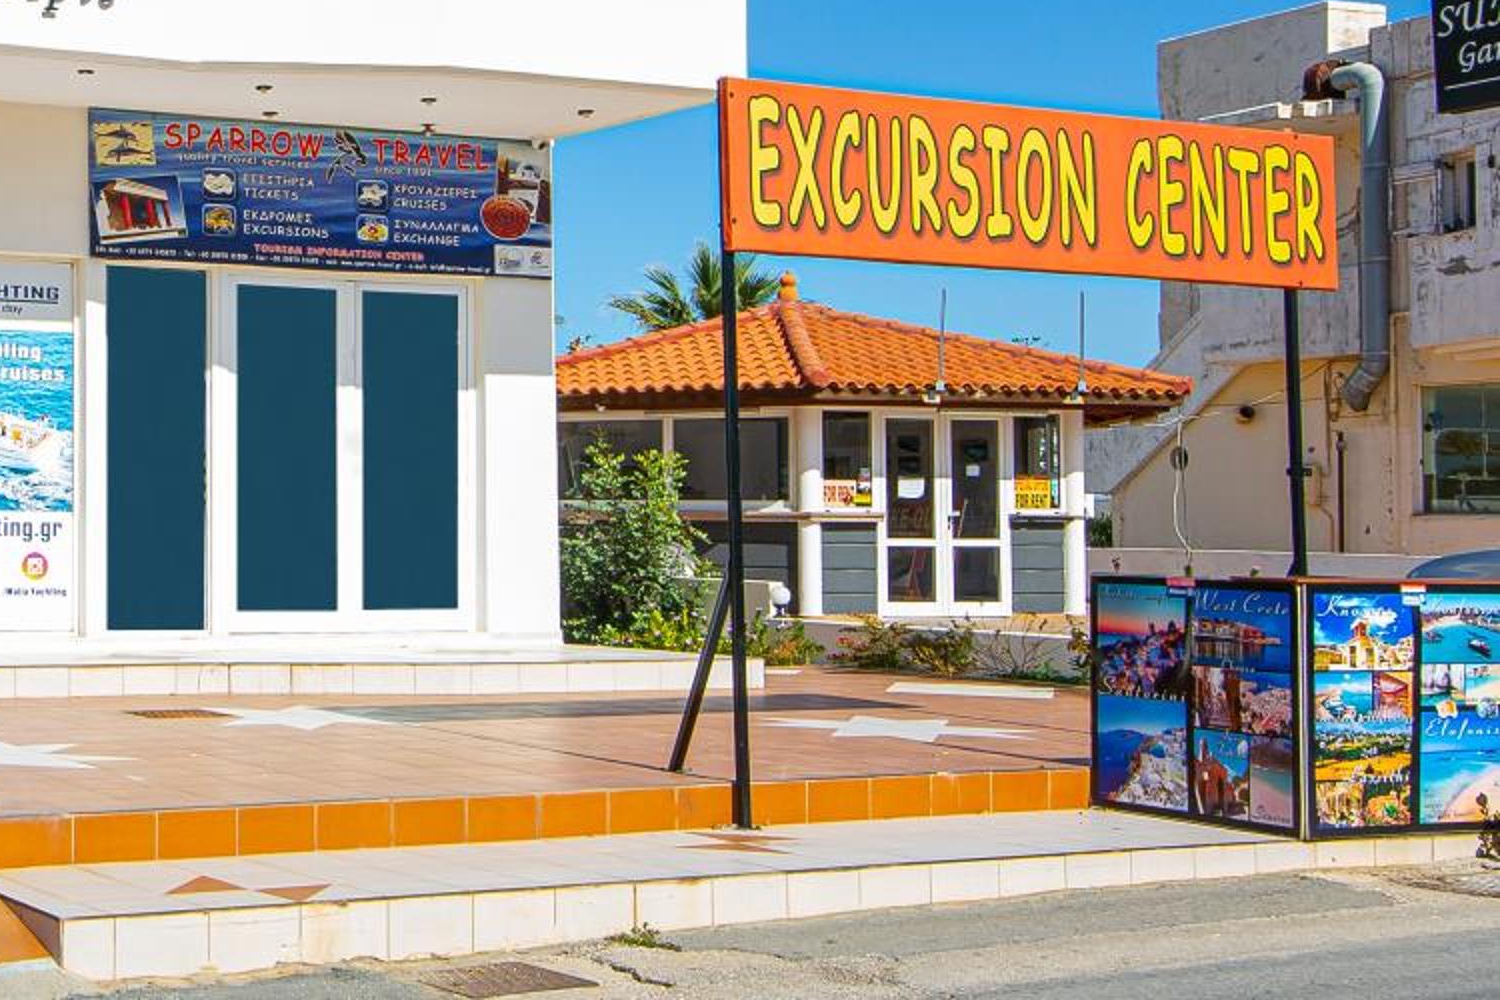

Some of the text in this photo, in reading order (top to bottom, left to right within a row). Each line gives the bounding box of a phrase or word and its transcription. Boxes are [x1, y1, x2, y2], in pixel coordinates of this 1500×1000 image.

[164, 122, 490, 173] SPARROW TRAVEL
[749, 93, 1326, 264] EXCURSION CENTER
[244, 187, 299, 201] TICKETS
[393, 198, 447, 211] CRUISES
[243, 224, 329, 239] EXCURSIONS
[393, 235, 461, 247] EXCHANGE
[306, 246, 383, 259] INFORMATION
[386, 251, 425, 262] CENTER
[1, 304, 23, 315] day
[1195, 590, 1288, 615] West Crete
